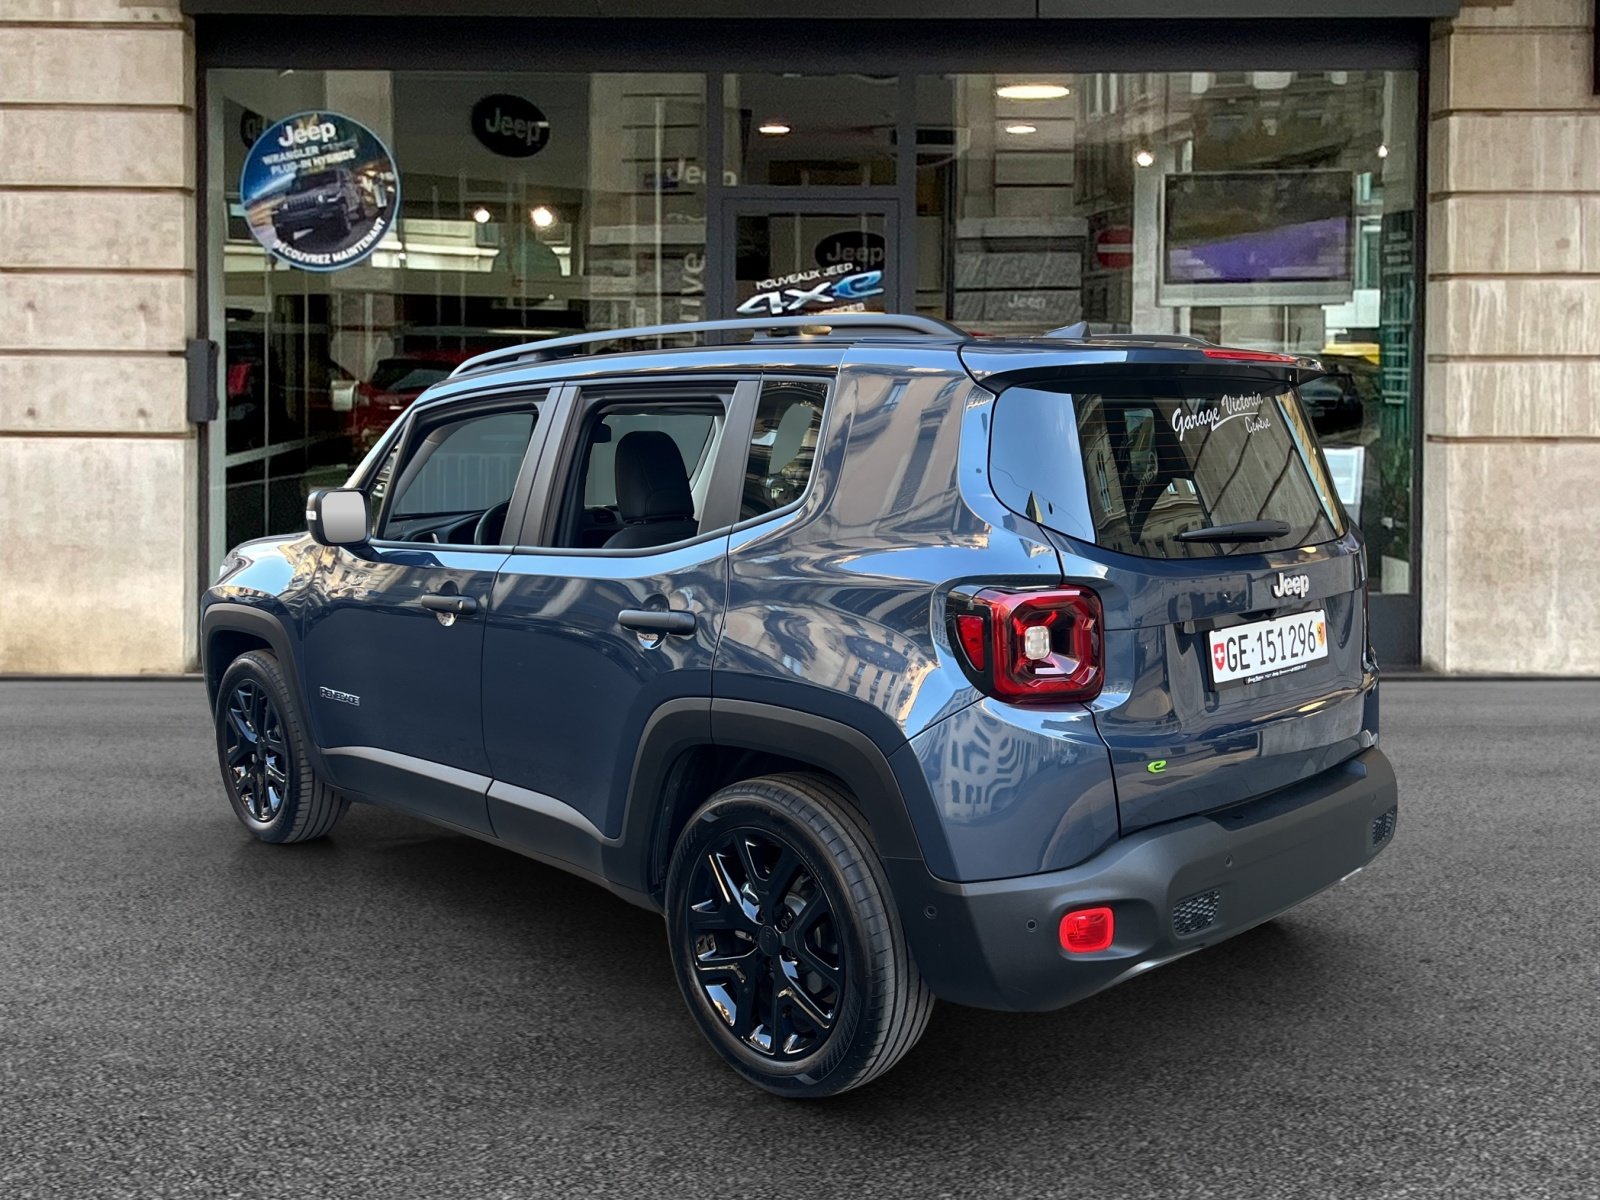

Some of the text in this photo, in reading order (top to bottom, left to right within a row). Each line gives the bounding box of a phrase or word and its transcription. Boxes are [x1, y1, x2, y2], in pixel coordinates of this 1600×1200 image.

[278, 122, 337, 147] Jeep
[485, 107, 541, 146] Jeep
[262, 145, 320, 165] WRANGLER
[826, 241, 883, 266] Jeep
[756, 262, 854, 290] NOUVEAUX JEEP
[1171, 391, 1264, 442] Garage Victoria
[1273, 572, 1310, 598] Jeep
[319, 686, 360, 706] RENEGADE
